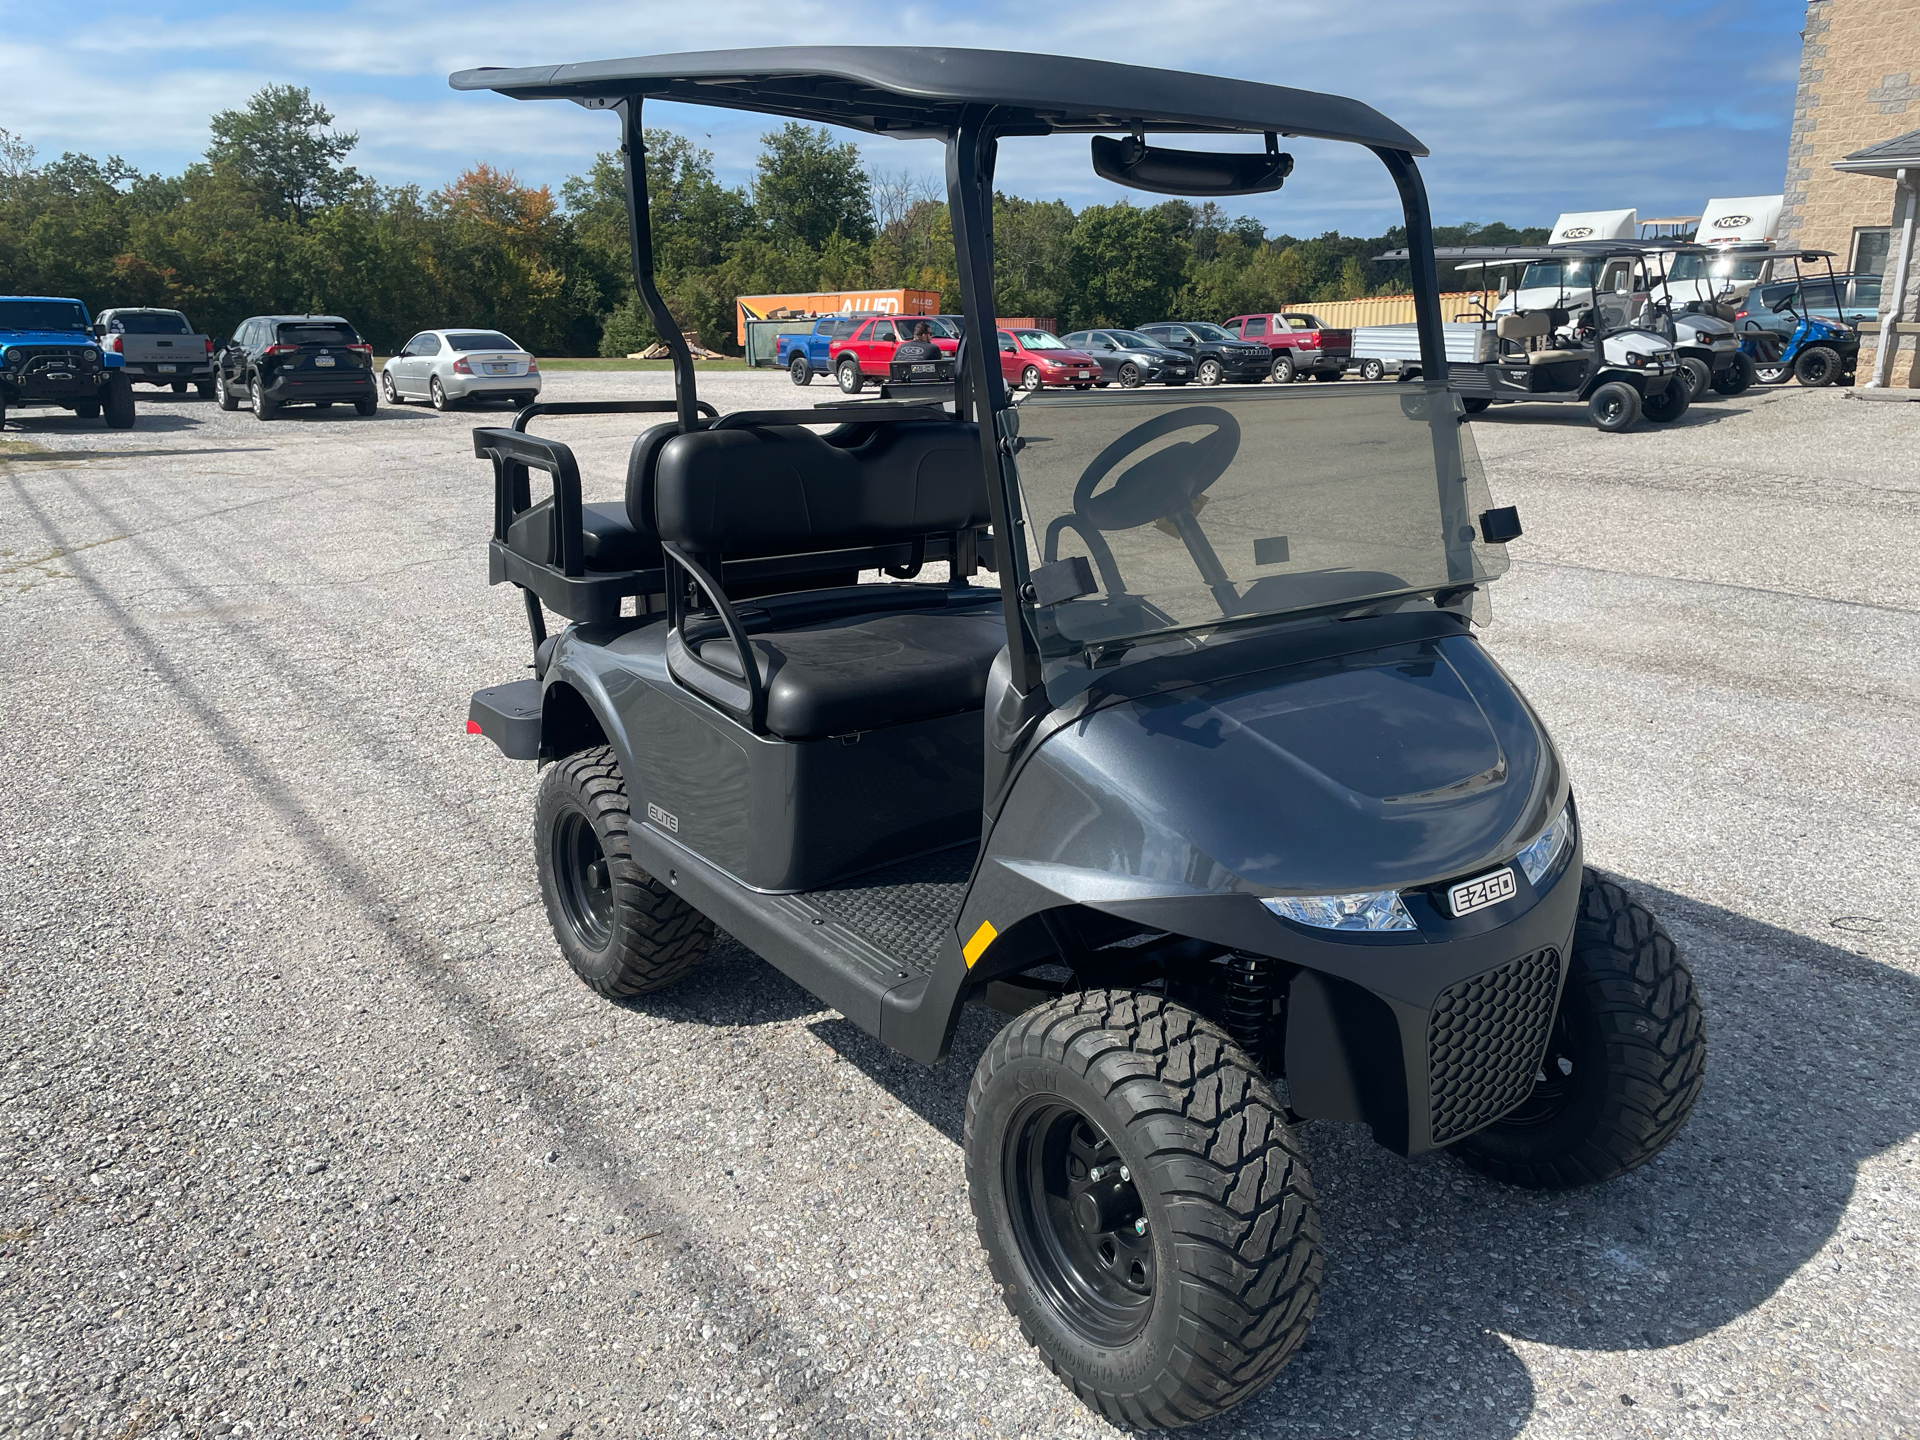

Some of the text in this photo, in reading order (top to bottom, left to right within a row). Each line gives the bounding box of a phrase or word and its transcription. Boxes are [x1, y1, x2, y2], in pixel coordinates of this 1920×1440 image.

[1722, 216, 1748, 226] GCS
[1569, 228, 1591, 237] GCS
[841, 297, 899, 316] ALLIED
[1454, 872, 1514, 911] EZGO
